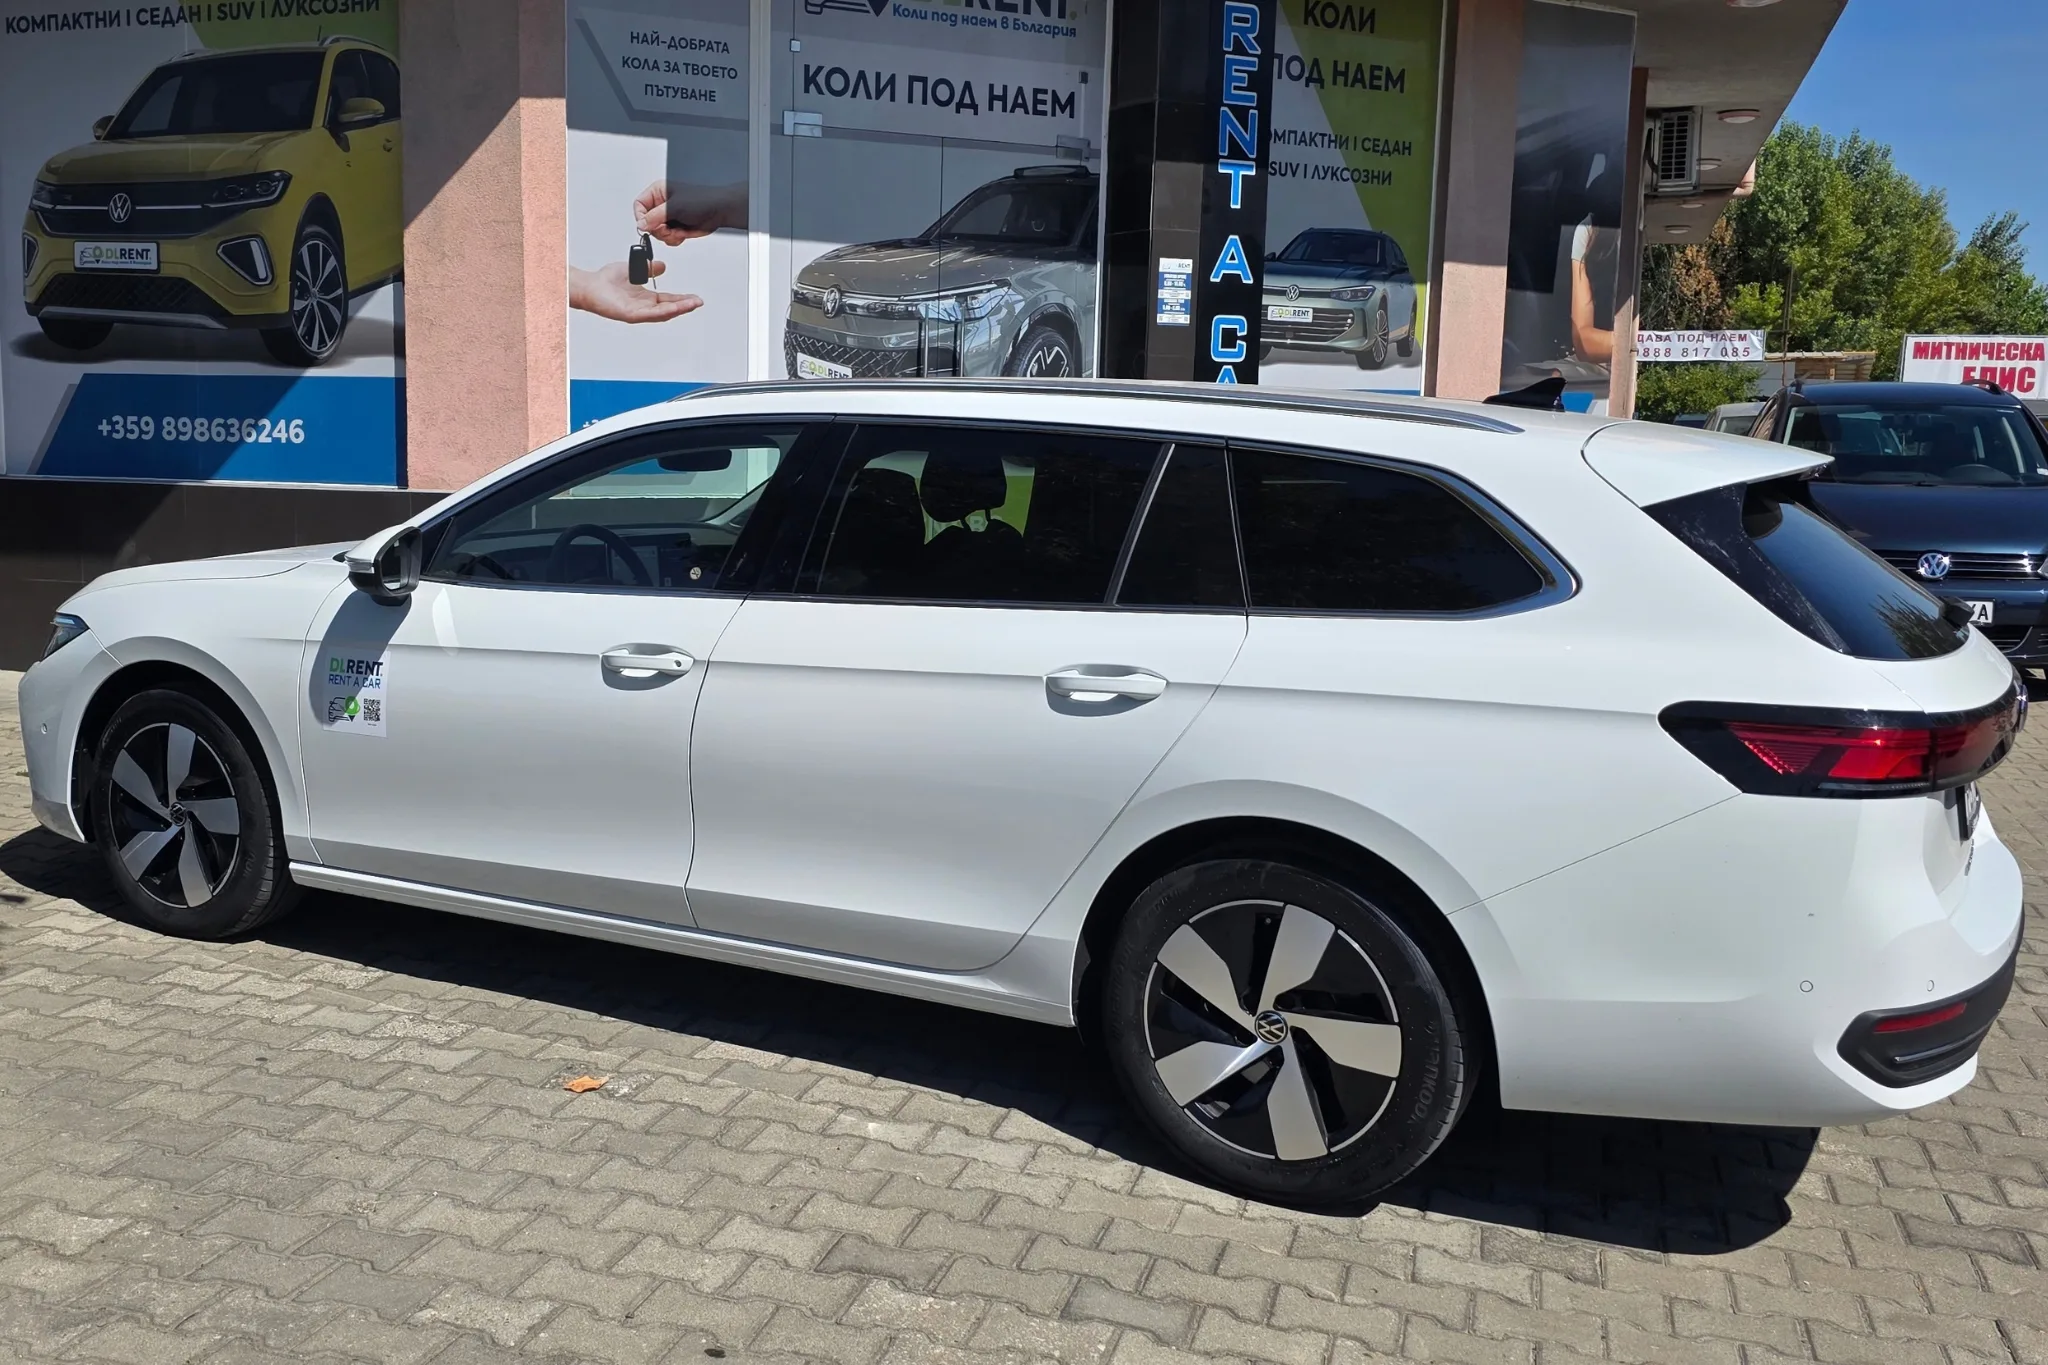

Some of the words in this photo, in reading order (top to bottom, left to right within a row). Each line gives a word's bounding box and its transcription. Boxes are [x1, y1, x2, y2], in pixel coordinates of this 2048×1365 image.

[5, 9, 121, 35] КОМПАКТНИ
[136, 4, 201, 28] СЕДАН
[217, 2, 254, 21] SUV
[271, 0, 380, 18] ЛУКСОЗНИ
[892, 3, 928, 20] Коли
[931, 11, 958, 27] под
[961, 15, 998, 28] наем
[1012, 18, 1077, 38] България
[1303, 0, 1376, 34] КОЛИ
[630, 30, 730, 54] НАЙ-ДОБРАТА
[621, 56, 660, 73] КОЛА
[663, 60, 680, 75] ЗА
[683, 62, 738, 80] ТВОЕТО
[1332, 60, 1406, 94] НАЕМ
[644, 83, 717, 103] ПЪТУВАНЕ
[803, 63, 897, 103] КОЛИ
[907, 74, 979, 116] ПОД
[988, 83, 1076, 119] НАЕМ
[1217, 1, 1261, 209] RENT
[1270, 128, 1350, 151] МПАКТНИ
[1361, 137, 1412, 156] СЕДАН
[1268, 161, 1300, 178] SUV
[1311, 164, 1393, 186] ЛУКСОЗНИ
[1210, 235, 1254, 284] A
[1636, 347, 1672, 358] 888
[1681, 347, 1711, 358] 817
[1720, 346, 1751, 358] 085
[1677, 333, 1705, 344] ПОД
[1711, 333, 1748, 343] НАЕМ
[1912, 341, 2046, 361] МИТНИЧЕСКА
[97, 414, 155, 441] +359
[161, 416, 306, 444] 898636246
[328, 674, 352, 687] RENT
[352, 677, 360, 688] A
[362, 678, 381, 689] CAR
